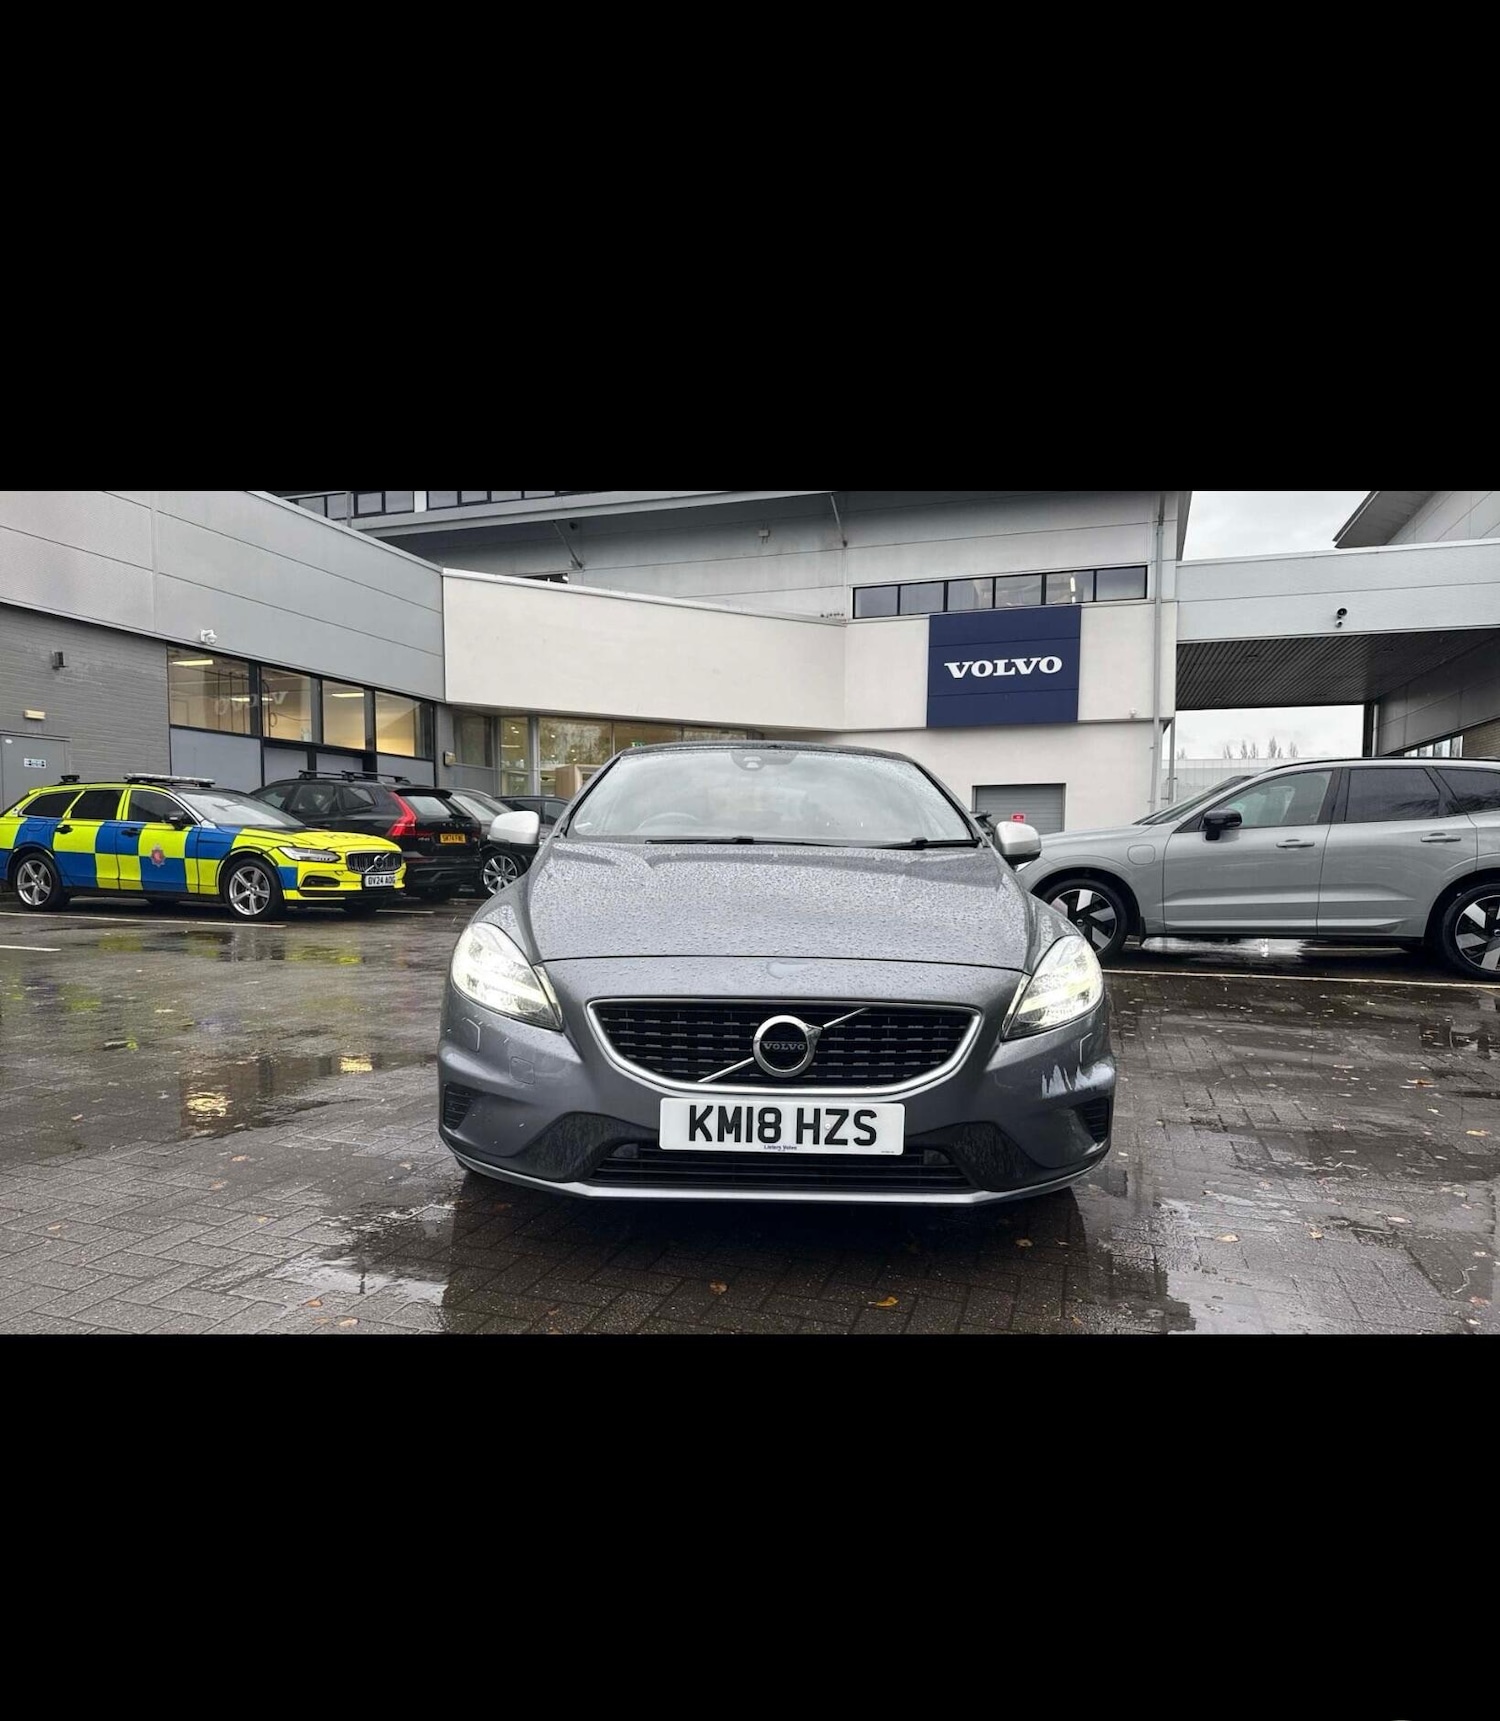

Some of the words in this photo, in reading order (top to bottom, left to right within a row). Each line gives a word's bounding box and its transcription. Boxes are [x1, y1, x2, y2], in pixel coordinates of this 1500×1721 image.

[943, 655, 1063, 679] VOLVO
[688, 1105, 782, 1144] KM18
[795, 1107, 878, 1146] HZS
